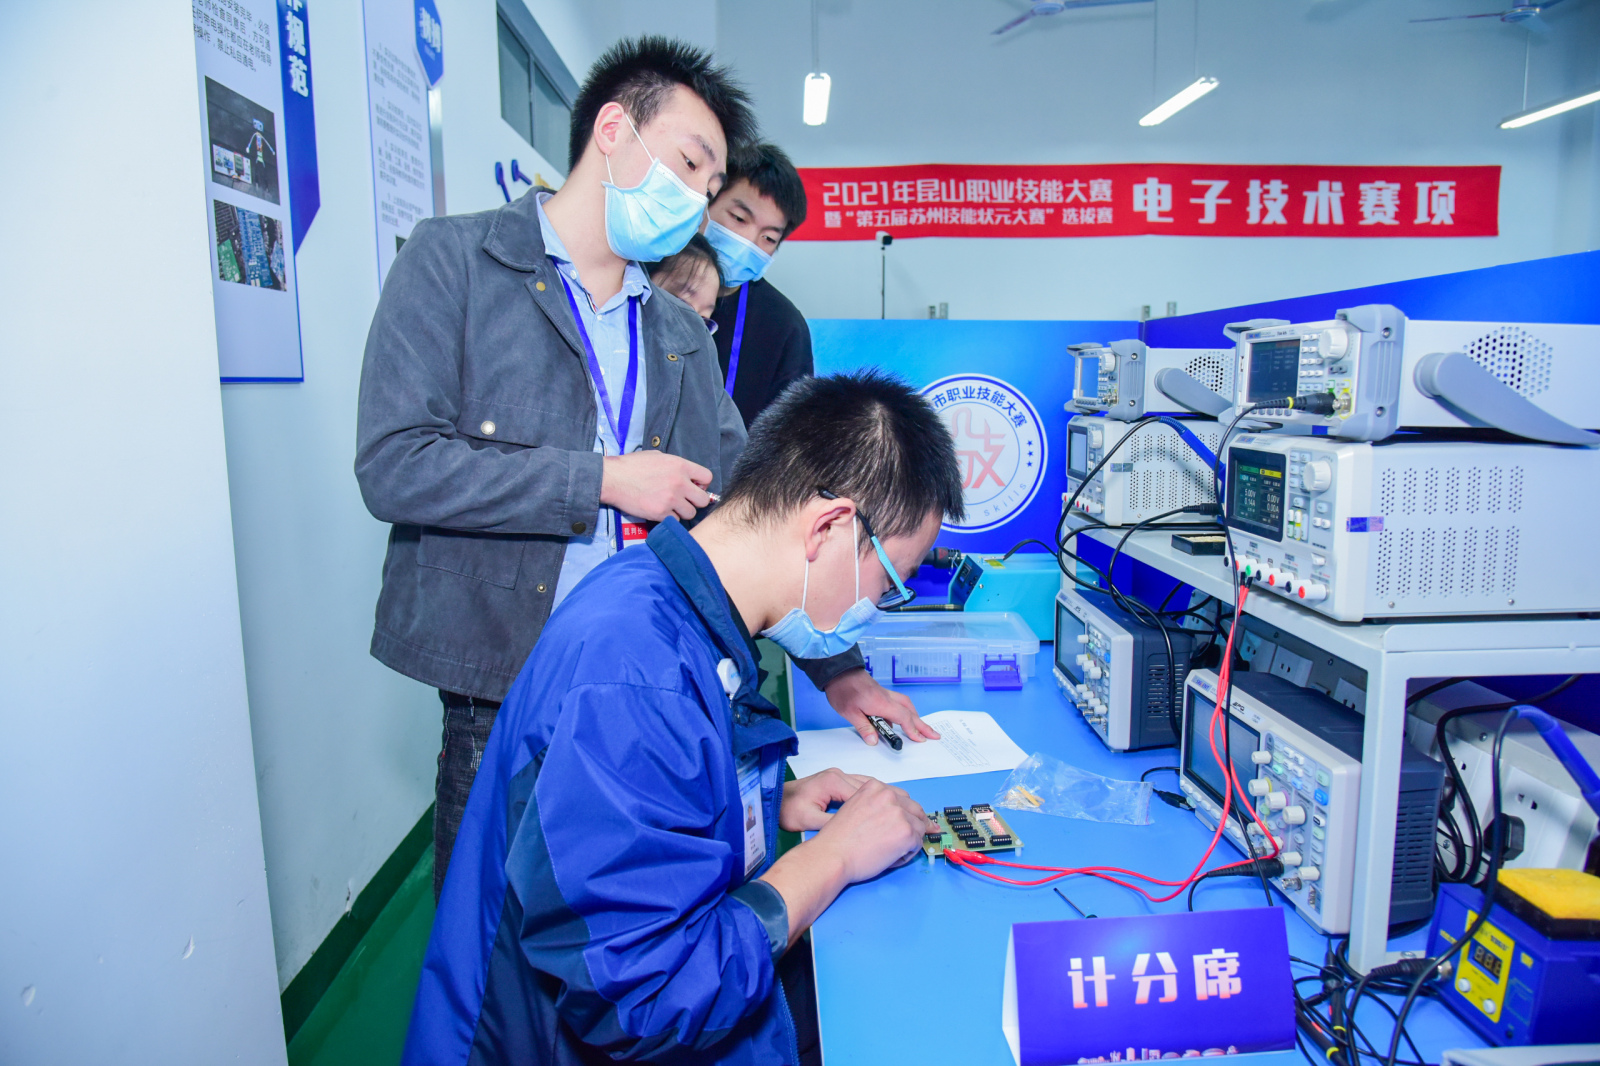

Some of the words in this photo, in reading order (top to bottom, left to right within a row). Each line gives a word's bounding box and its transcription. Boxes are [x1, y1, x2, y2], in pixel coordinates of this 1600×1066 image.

[822, 178, 1113, 206] 2021年昆山职业技能大赛
[1132, 176, 1457, 225] 电子技术赛项
[1067, 948, 1243, 1009] 计分席
